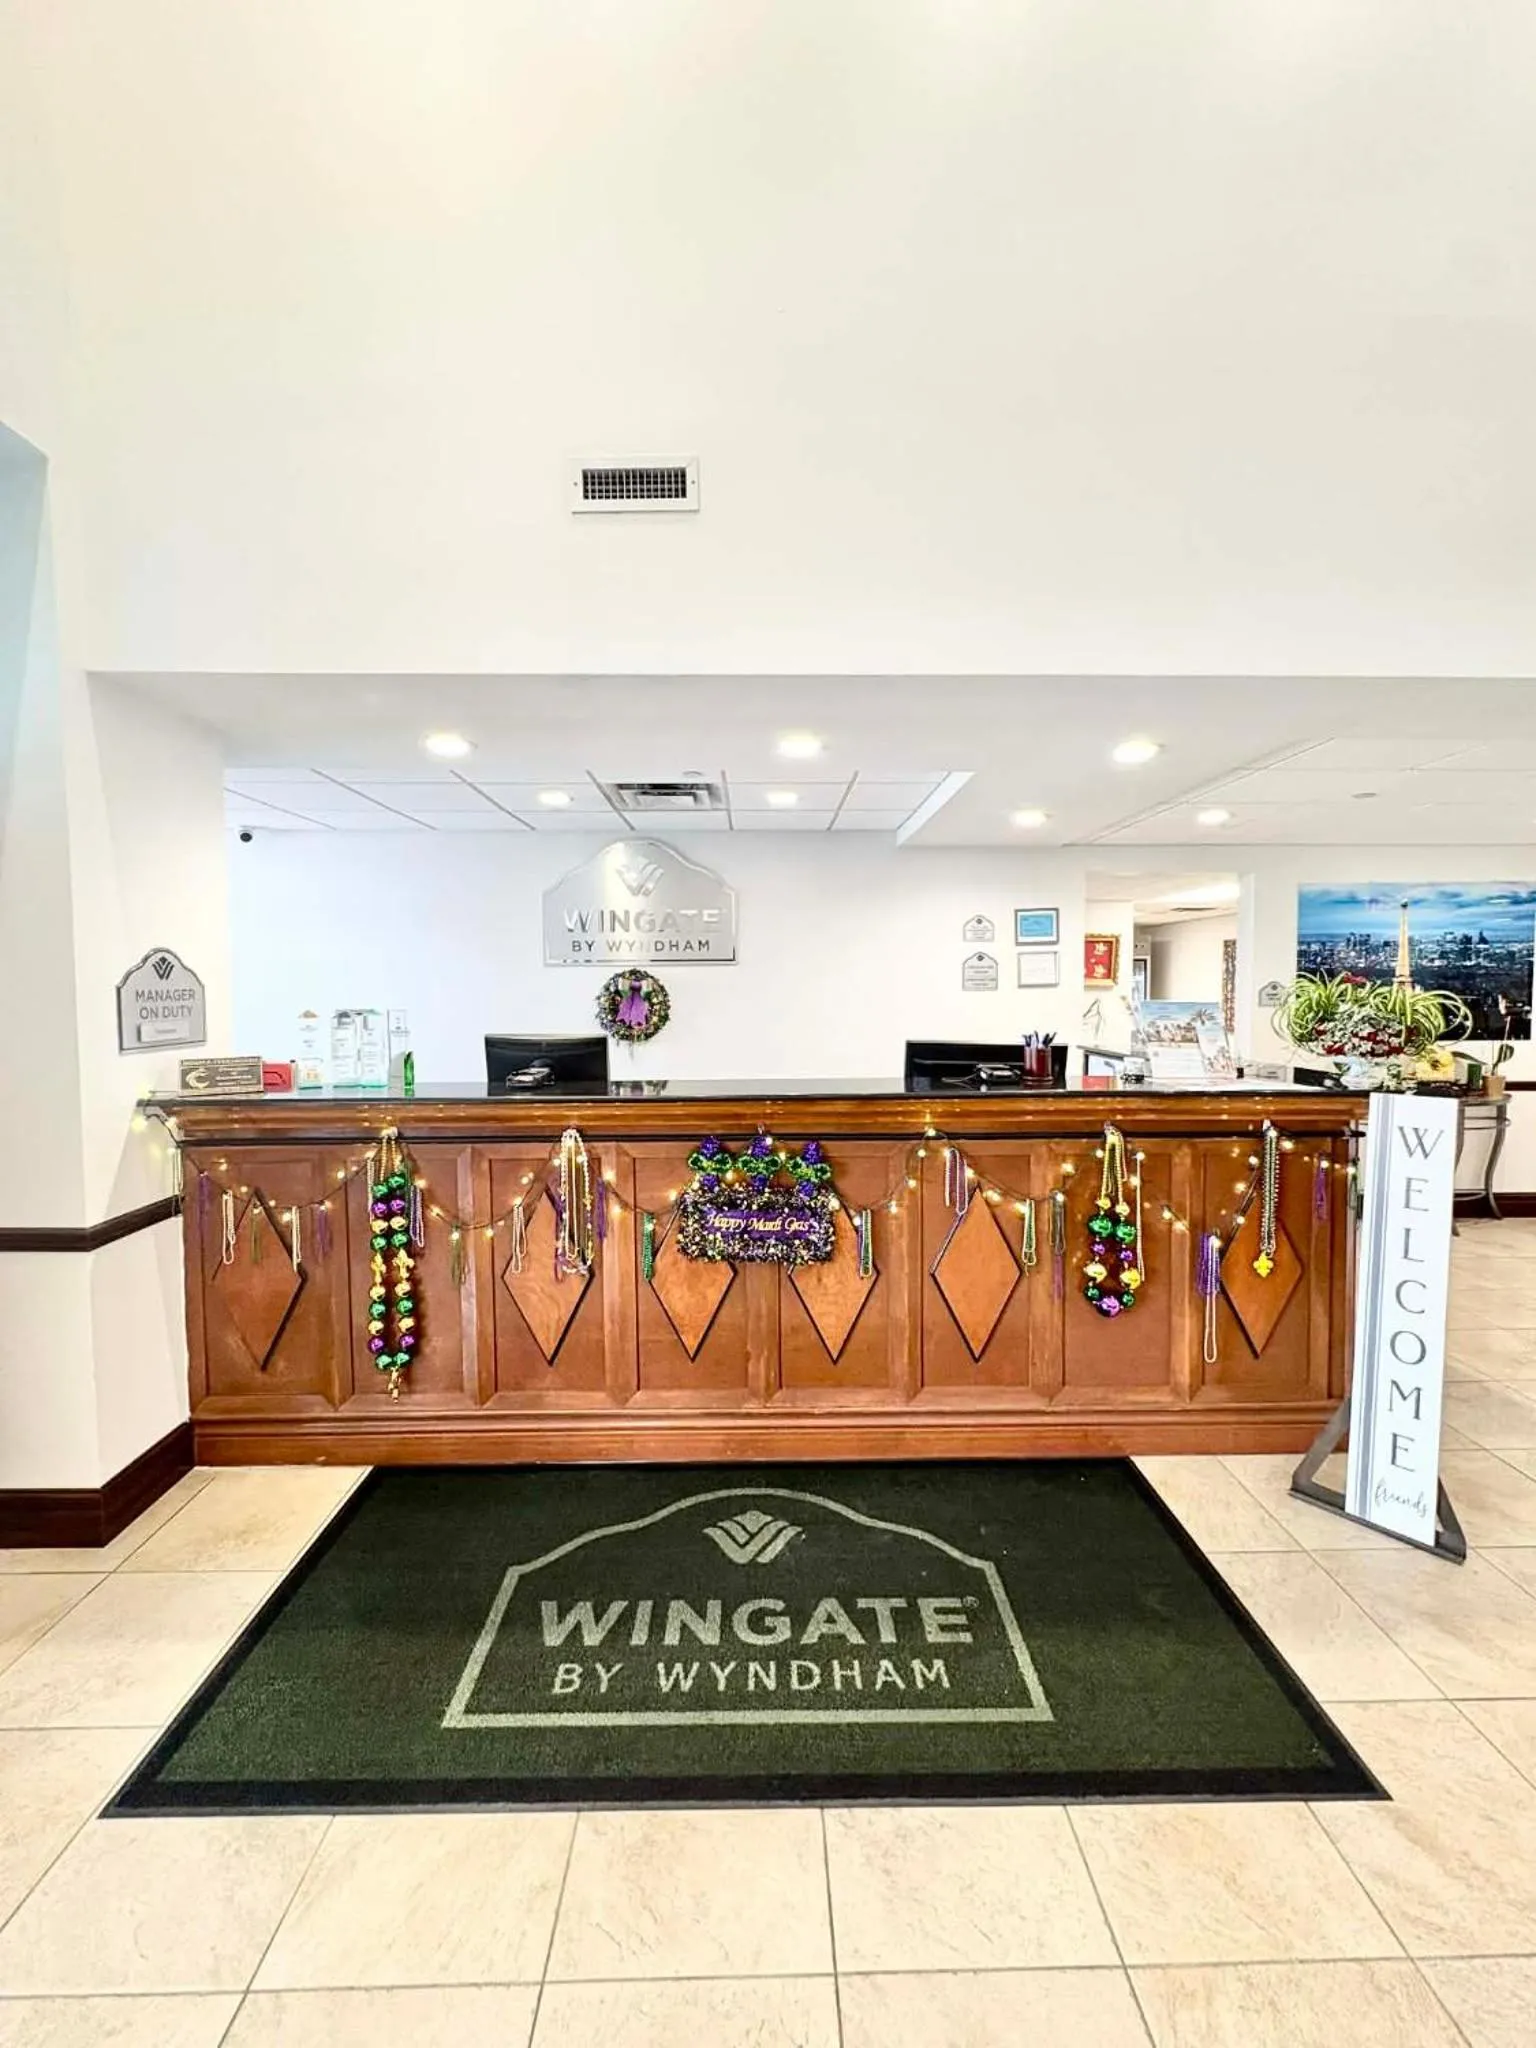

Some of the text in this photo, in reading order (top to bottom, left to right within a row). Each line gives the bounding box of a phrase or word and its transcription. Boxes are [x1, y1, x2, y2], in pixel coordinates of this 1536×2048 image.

[564, 909, 722, 933] WINGATE
[571, 940, 595, 952] BY
[136, 988, 195, 1002] MANAGER
[140, 1004, 193, 1019] ON DUTY
[705, 1214, 746, 1232] Happy
[748, 1216, 782, 1231] Mardi
[1387, 1126, 1445, 1472] WELCOME
[551, 1659, 950, 1694] BY WYNDHAM
